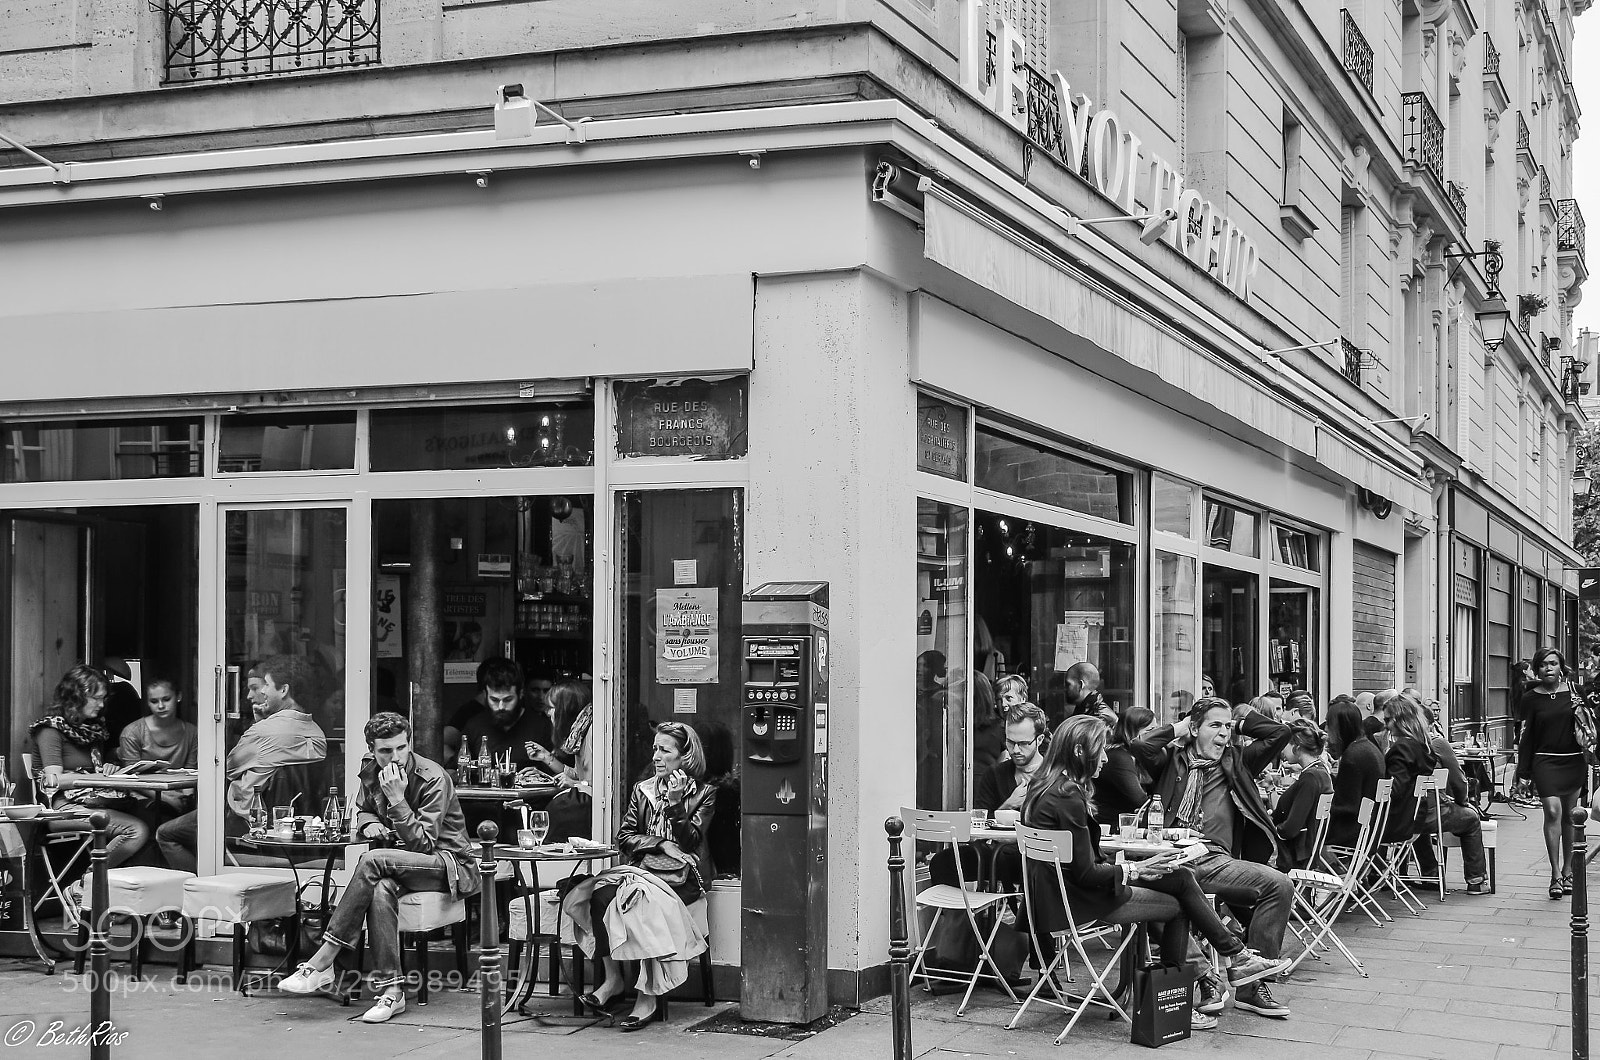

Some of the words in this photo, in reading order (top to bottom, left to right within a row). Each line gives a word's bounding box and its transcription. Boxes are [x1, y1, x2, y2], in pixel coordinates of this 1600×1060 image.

[958, 0, 1028, 136] LE
[654, 402, 679, 413] RUE
[684, 401, 708, 412] DES
[658, 418, 704, 430] FRANCS
[926, 417, 938, 430] RUE
[649, 435, 713, 447] BOURGEOIS
[670, 646, 707, 658] VOLUME
